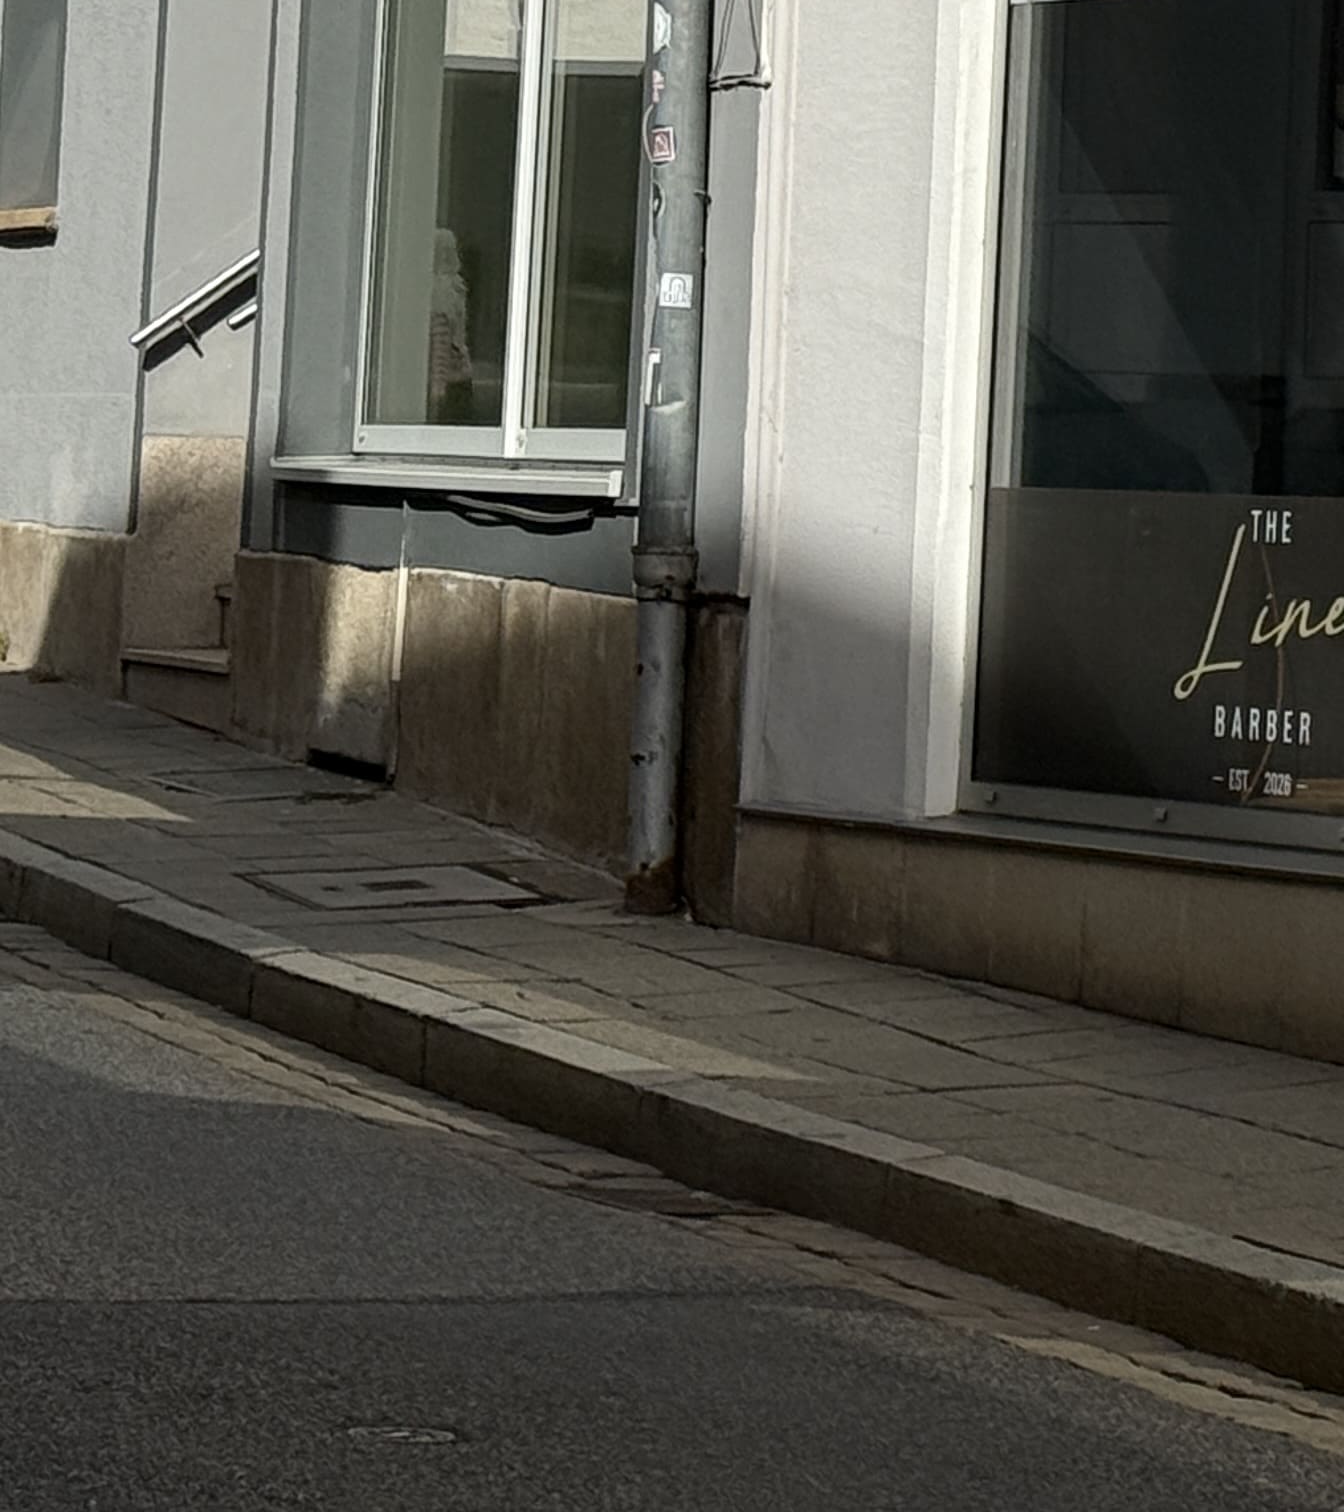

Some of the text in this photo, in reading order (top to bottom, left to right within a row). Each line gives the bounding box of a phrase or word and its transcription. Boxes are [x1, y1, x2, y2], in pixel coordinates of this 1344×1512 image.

[1251, 510, 1292, 543] THE
[1214, 705, 1311, 745] BARBER
[1263, 772, 1292, 797] 2026
